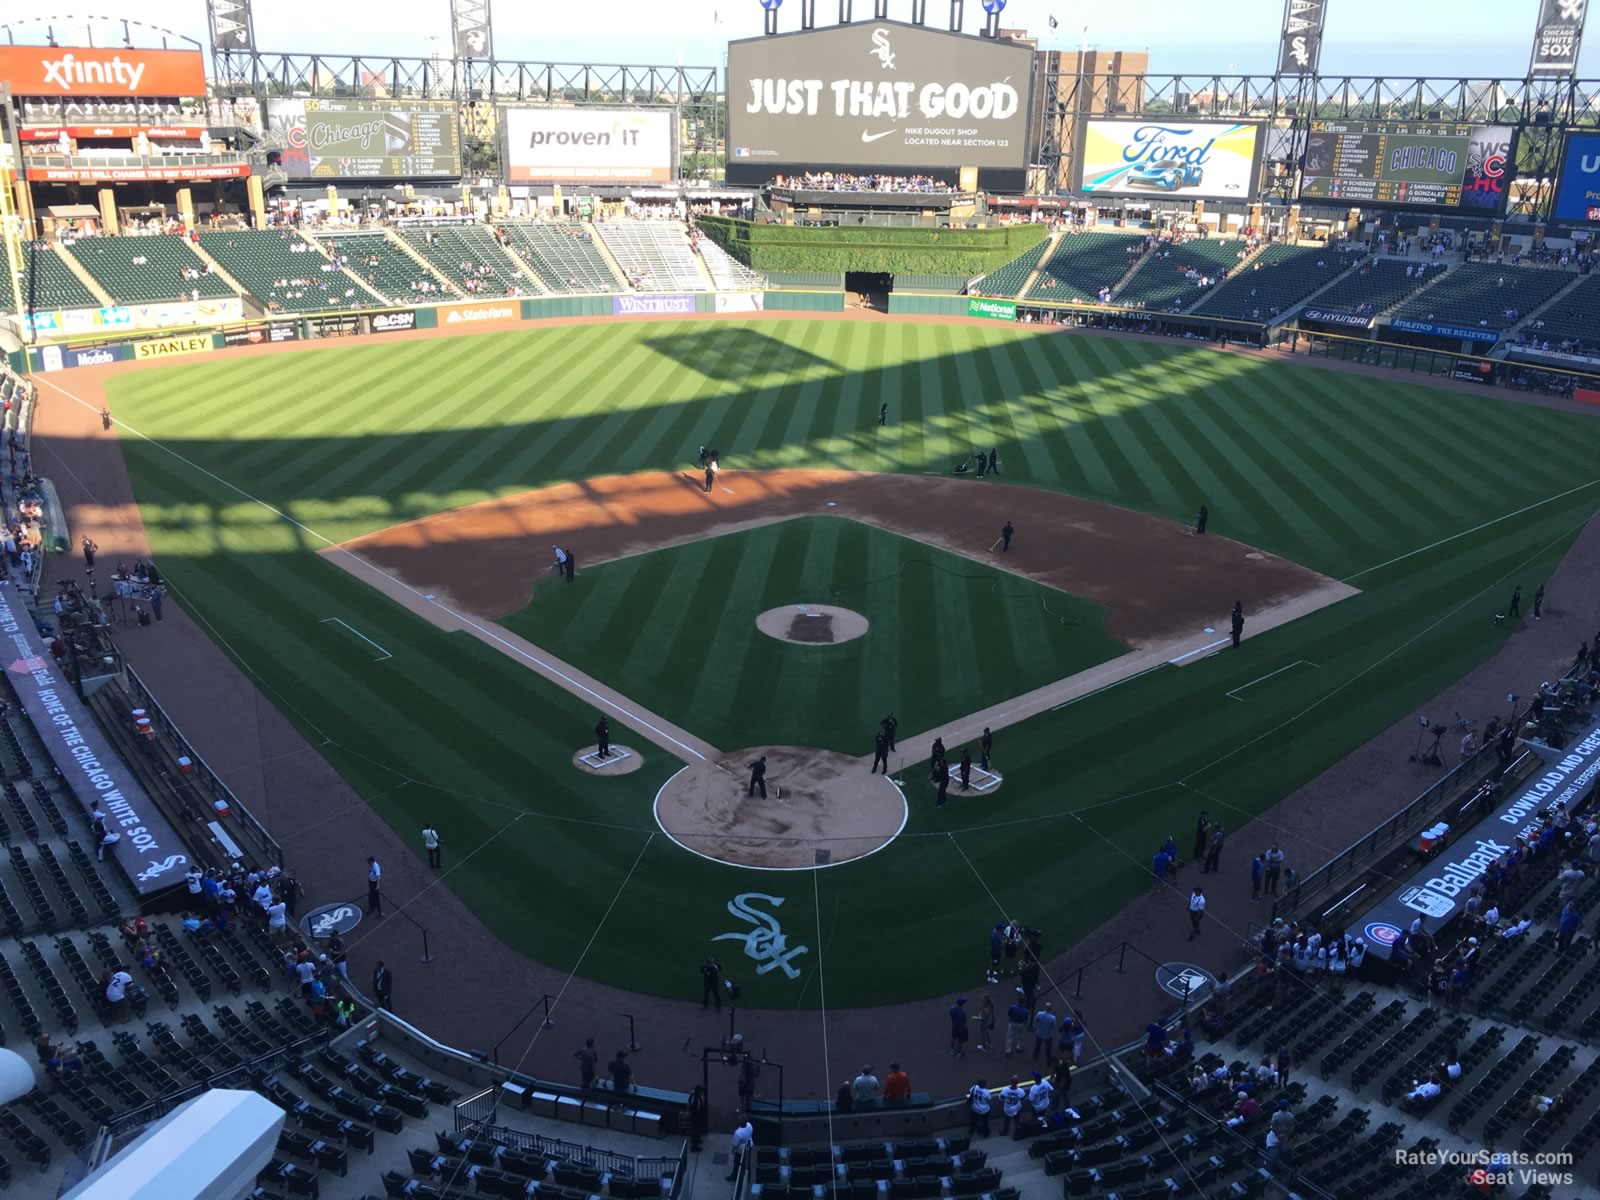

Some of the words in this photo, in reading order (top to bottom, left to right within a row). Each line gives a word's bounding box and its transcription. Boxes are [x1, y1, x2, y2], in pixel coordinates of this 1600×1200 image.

[1540, 44, 1572, 56] SOX
[42, 54, 144, 90] xfinity
[304, 100, 320, 110] 50
[746, 79, 823, 116] JUST
[830, 79, 915, 118] THAT
[919, 77, 1018, 119] GOOD
[310, 120, 384, 150] Chicago
[1312, 121, 1326, 132] 34
[530, 131, 610, 148] proven
[622, 130, 639, 146] IT
[1122, 126, 1216, 166] Ford
[1390, 146, 1457, 174] CHICAGO
[47, 170, 78, 178] XFINITY
[91, 170, 112, 178] WILL
[112, 170, 146, 178] CHANGE
[146, 170, 162, 178] THE
[163, 170, 180, 178] WAY
[196, 168, 232, 176] EXPERIENCE
[619, 298, 690, 310] WINTRUST
[980, 302, 1014, 314] National
[389, 313, 414, 325] CSN
[1322, 313, 1369, 325] HYUNDAI
[1393, 320, 1432, 331] ATHLETICO
[1453, 329, 1497, 341] RELIEVERS
[141, 338, 207, 356] STANLEY
[78, 351, 114, 366] Modelo
[32, 668, 56, 687] Field
[37, 688, 65, 714] HOME
[52, 713, 73, 726] OF
[60, 724, 84, 746] THE
[70, 745, 114, 790] CHICAGO
[1500, 772, 1565, 824] DOWNLOAD
[1556, 754, 1584, 774] AND
[102, 788, 140, 827] WHITE
[126, 826, 159, 853] SOX
[1425, 839, 1510, 897] Ballpark
